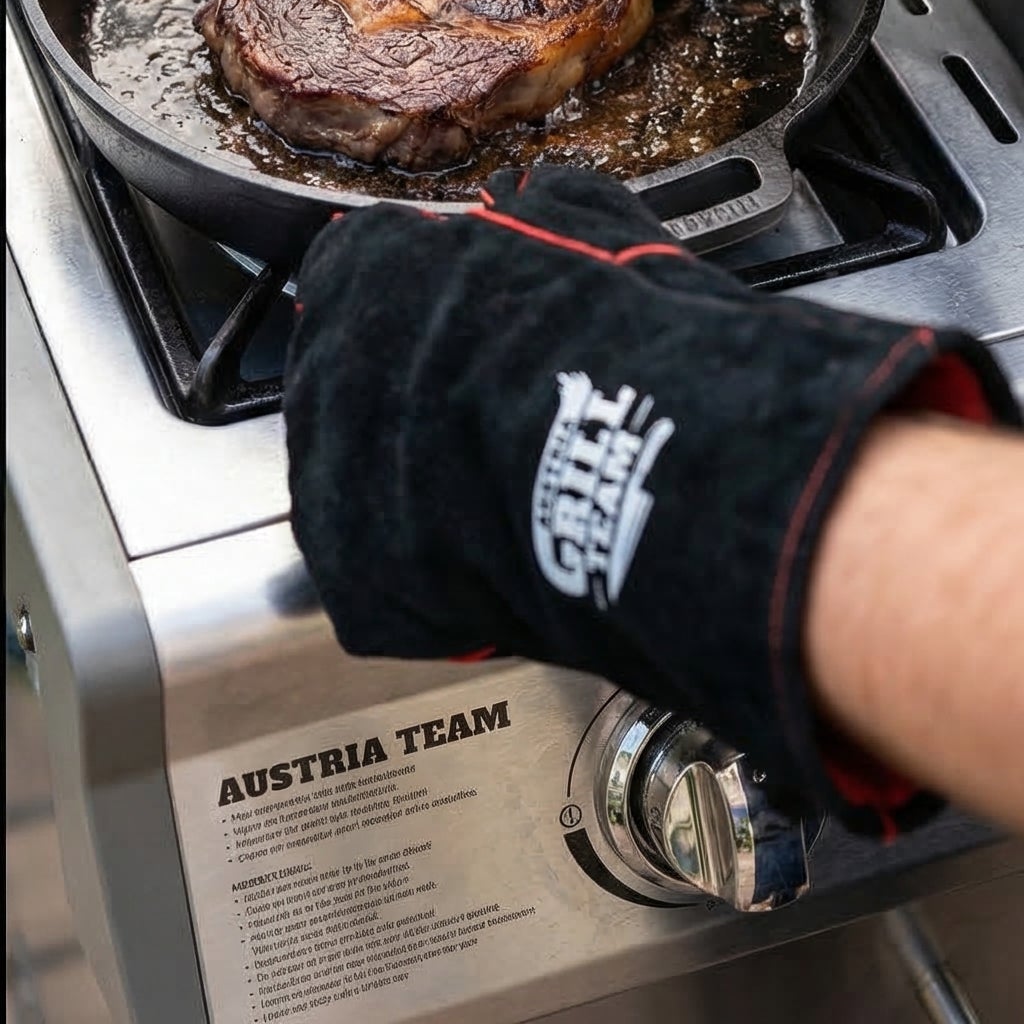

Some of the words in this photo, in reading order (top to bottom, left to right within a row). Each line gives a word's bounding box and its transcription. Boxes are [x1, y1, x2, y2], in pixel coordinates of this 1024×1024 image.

[532, 384, 637, 598] GRILL
[585, 428, 644, 576] TEAM
[218, 737, 388, 807] AUSTRIA
[395, 700, 511, 755] TEAM
